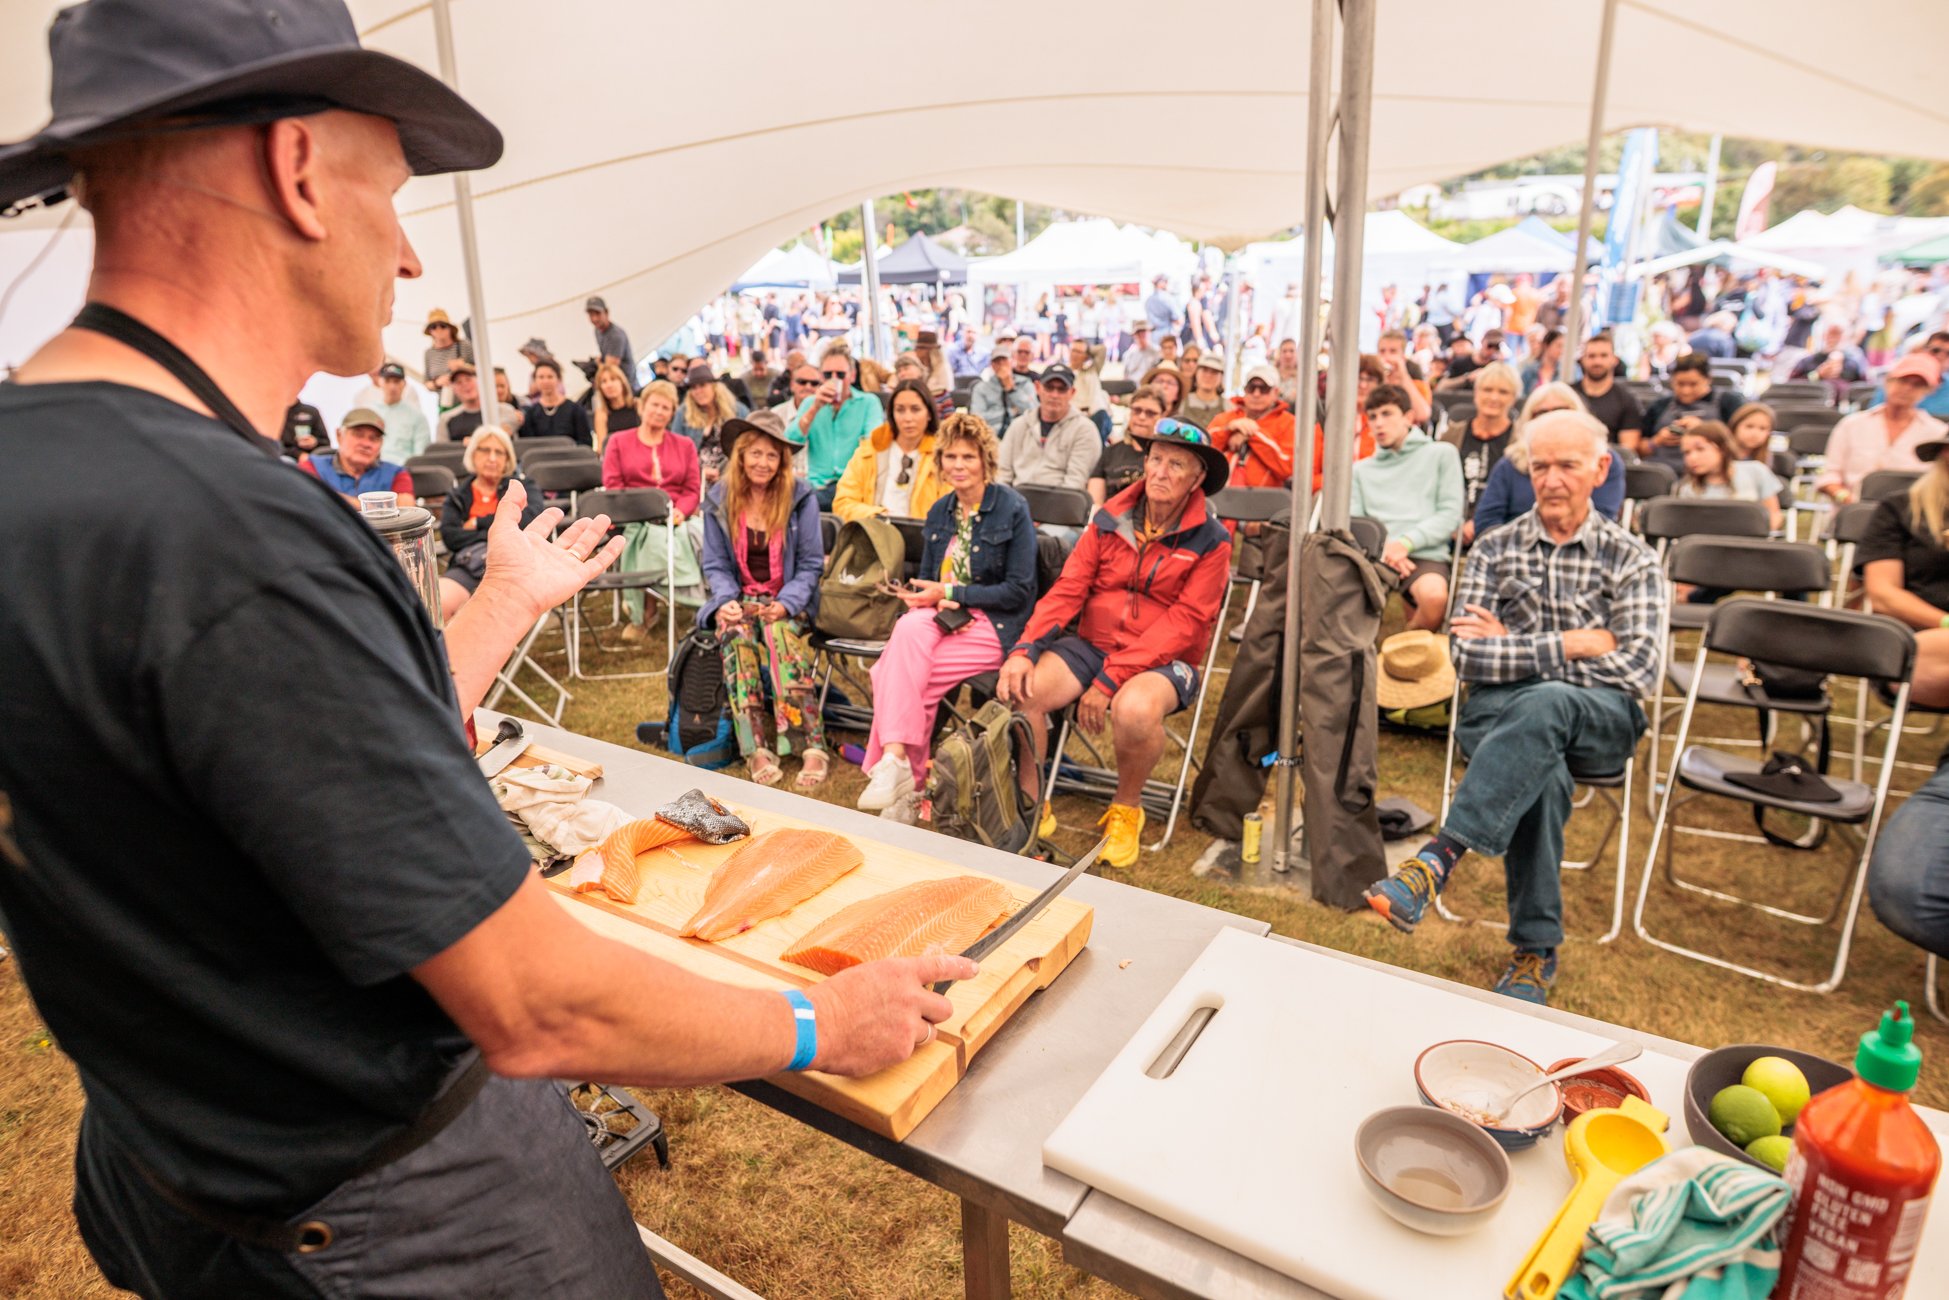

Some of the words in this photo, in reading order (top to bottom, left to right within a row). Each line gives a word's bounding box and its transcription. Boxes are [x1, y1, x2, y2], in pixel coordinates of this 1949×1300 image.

[1813, 1190, 1873, 1227] GLUTEN
[1817, 1173, 1849, 1200] NON
[1852, 1191, 1889, 1214] GMO
[1810, 1202, 1847, 1231] FREE
[1808, 1219, 1859, 1254] VEGAN
